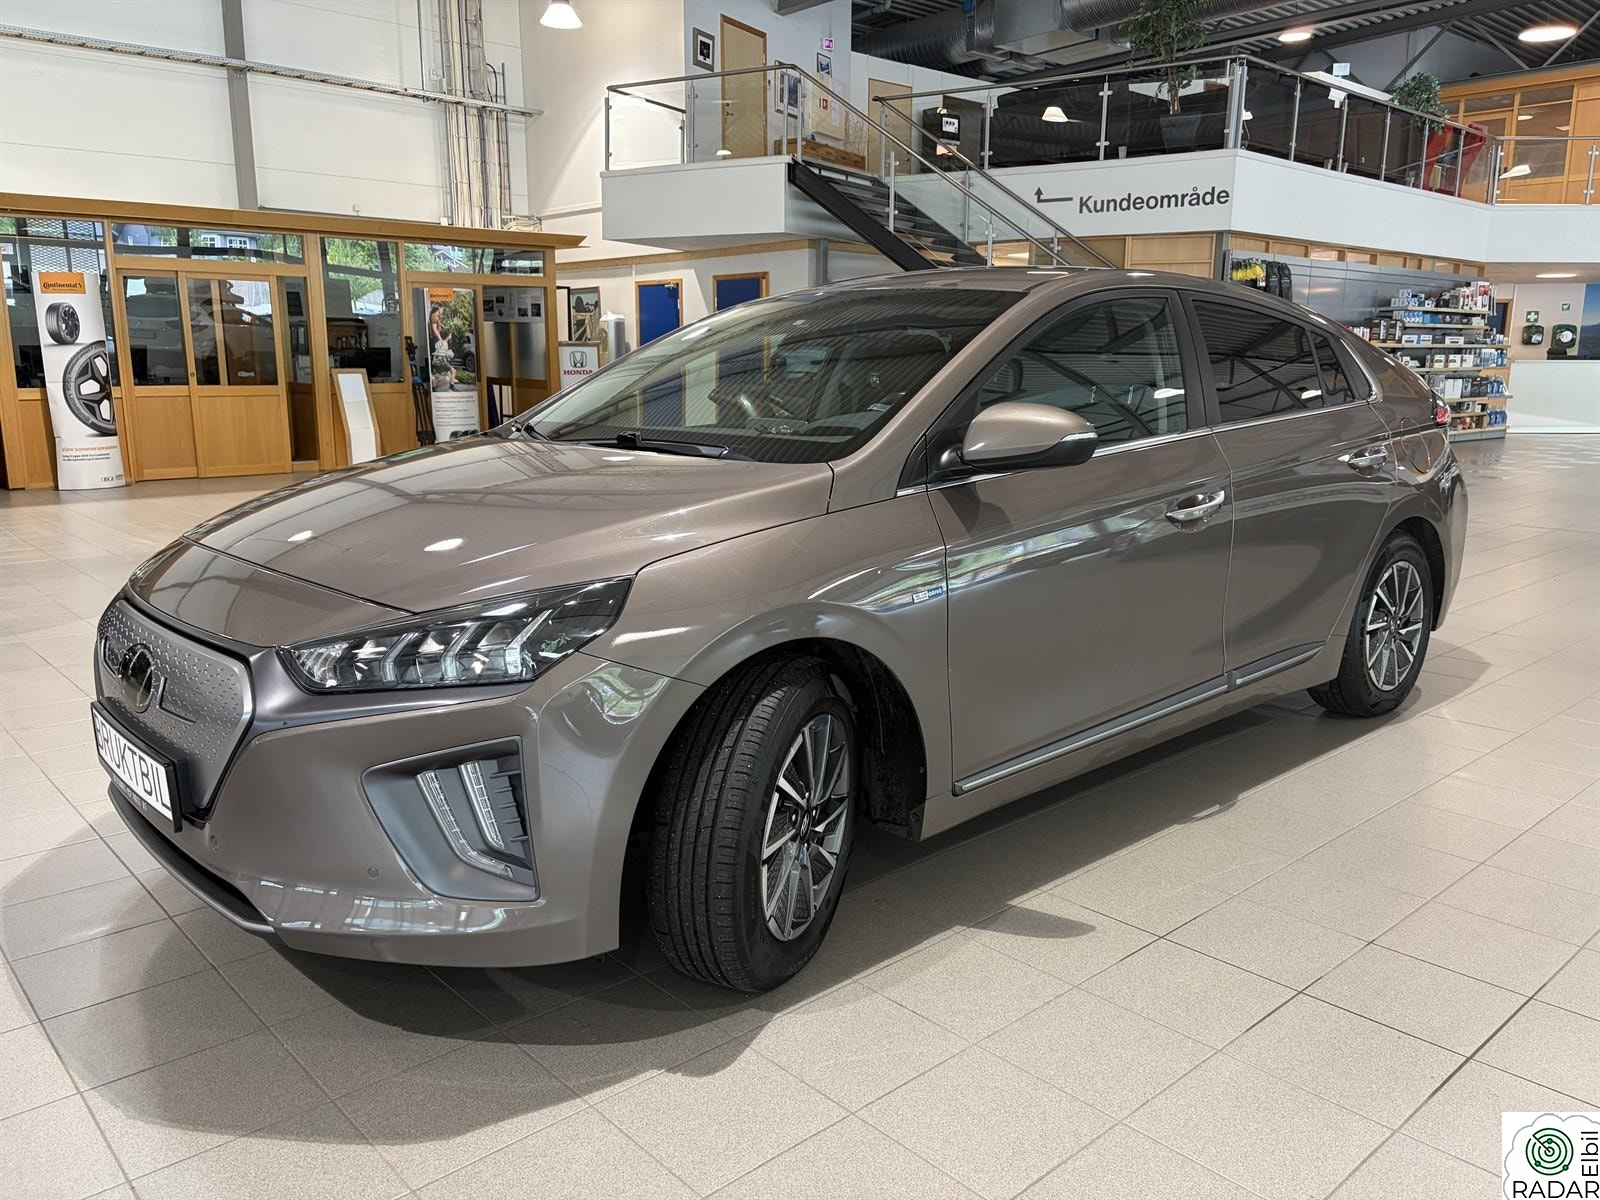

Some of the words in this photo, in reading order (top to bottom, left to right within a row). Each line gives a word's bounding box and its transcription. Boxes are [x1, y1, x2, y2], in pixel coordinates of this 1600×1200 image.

[1079, 186, 1230, 214] Kundeområde
[43, 281, 77, 290] Continental
[93, 714, 171, 812] BRUKTBIL
